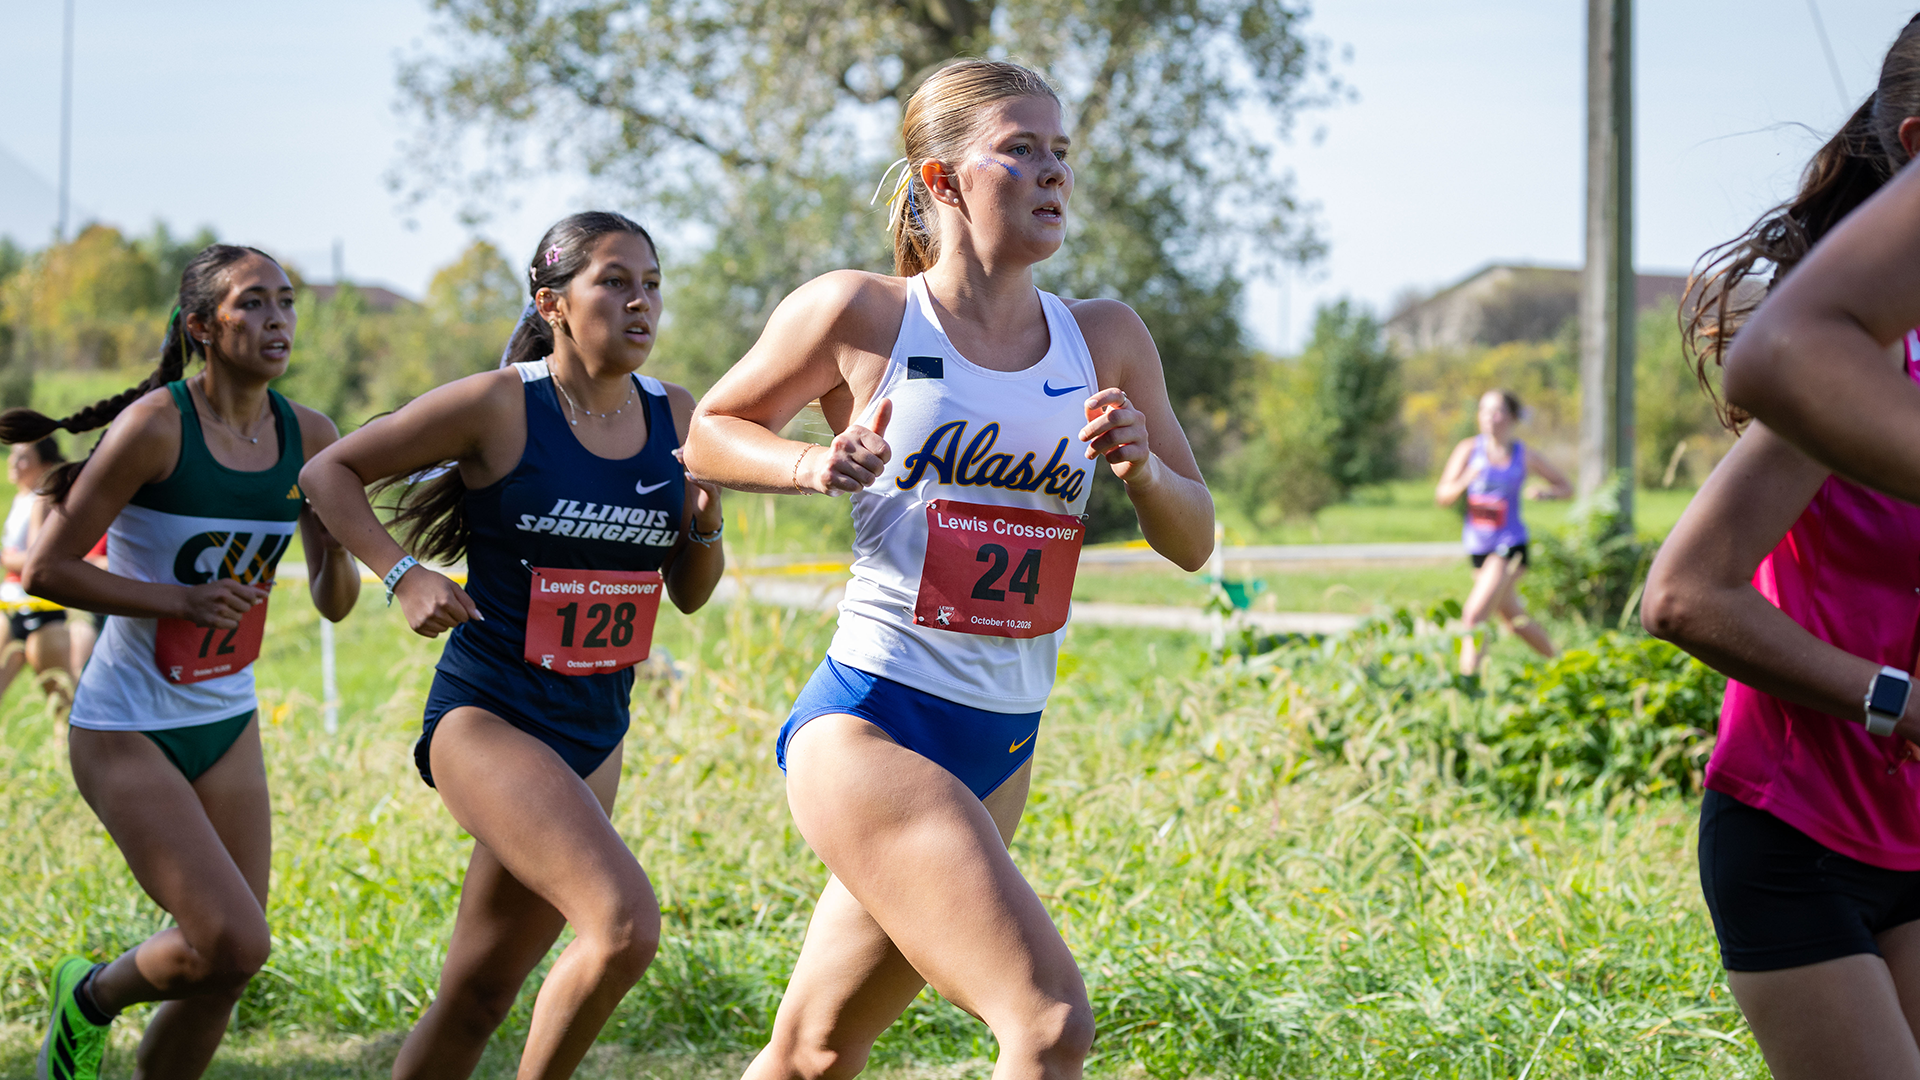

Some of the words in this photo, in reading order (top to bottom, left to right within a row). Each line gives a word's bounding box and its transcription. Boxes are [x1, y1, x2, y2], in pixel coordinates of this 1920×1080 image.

[895, 420, 1086, 503] Alaska
[548, 498, 669, 529] ILLINOIS
[937, 512, 988, 533] Lewis
[993, 518, 1079, 541] Crossover
[540, 578, 585, 594] Lewis
[588, 580, 658, 595] Crossover
[971, 543, 1042, 605] 24
[556, 602, 637, 648] 128
[970, 615, 1004, 627] October
